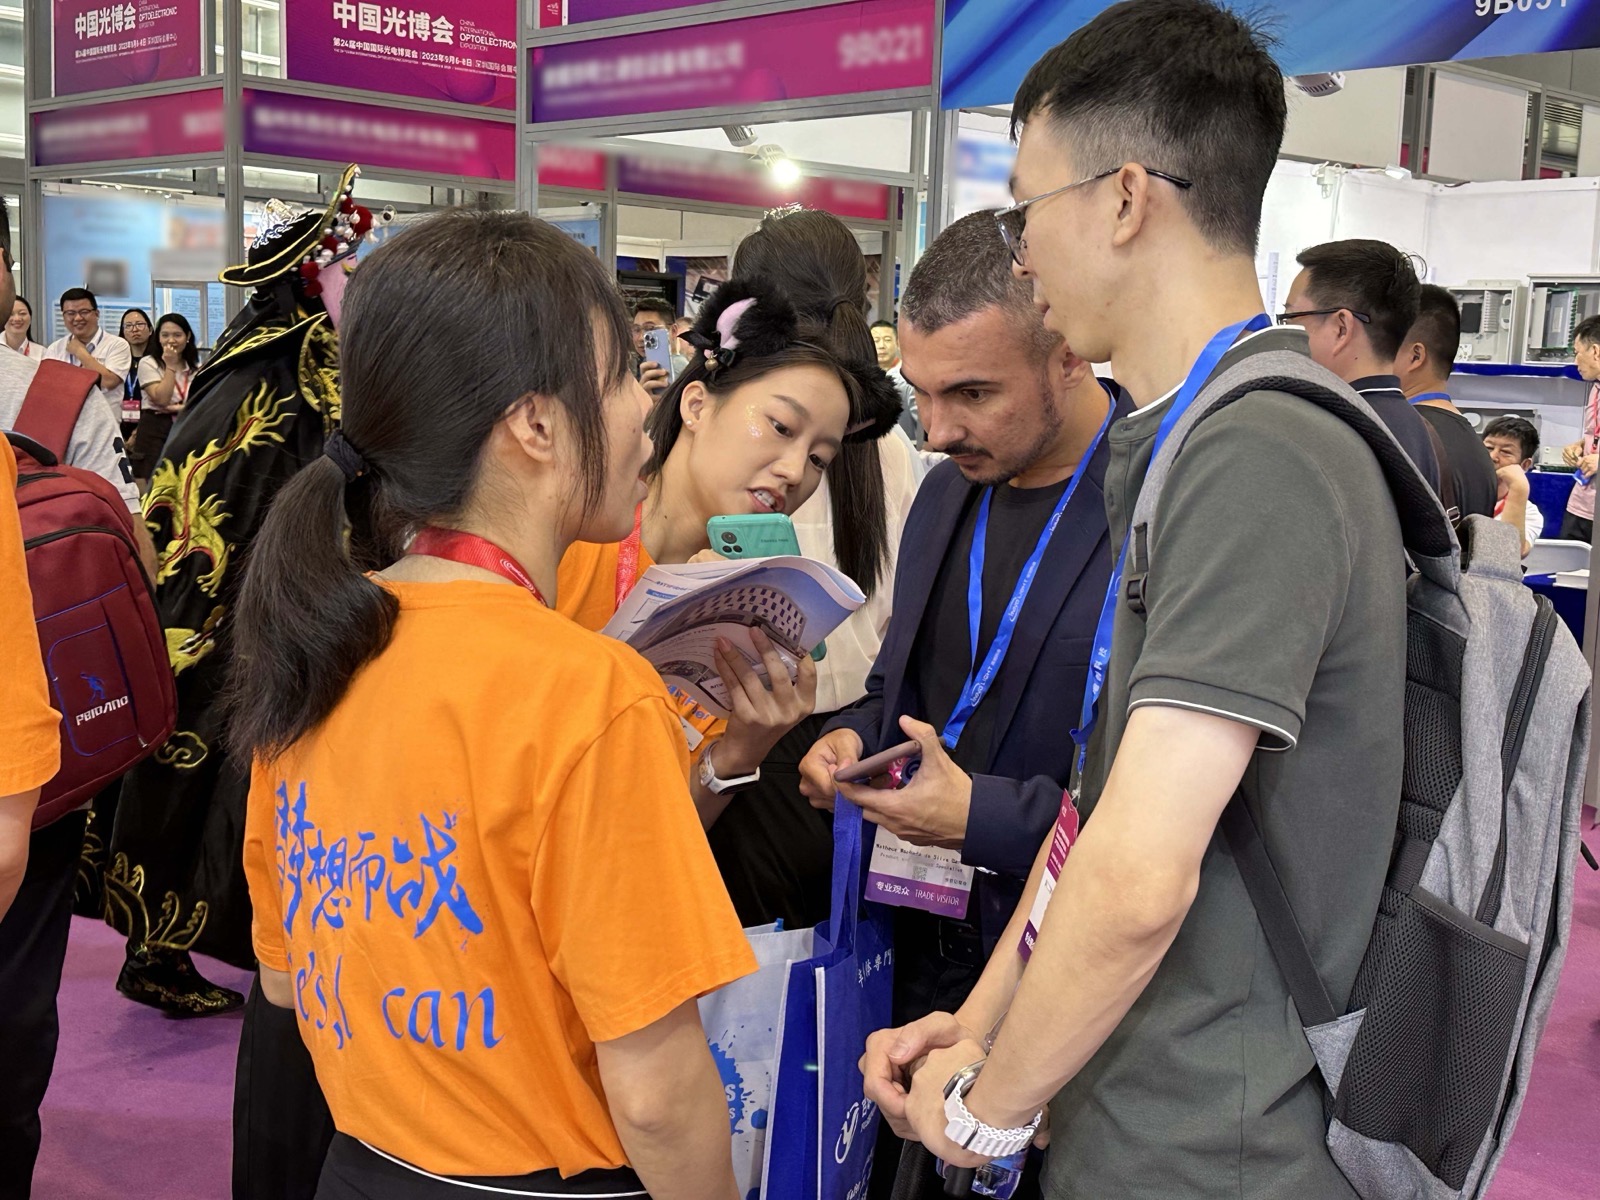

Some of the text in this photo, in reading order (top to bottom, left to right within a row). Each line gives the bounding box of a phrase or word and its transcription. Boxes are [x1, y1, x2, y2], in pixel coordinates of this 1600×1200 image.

[75, 2, 137, 40] 中国光博会
[333, 0, 454, 45] 中国光博会
[876, 881, 910, 896] 专业观众
[914, 888, 960, 906] TRADE VISITOR
[381, 986, 506, 1052] can
